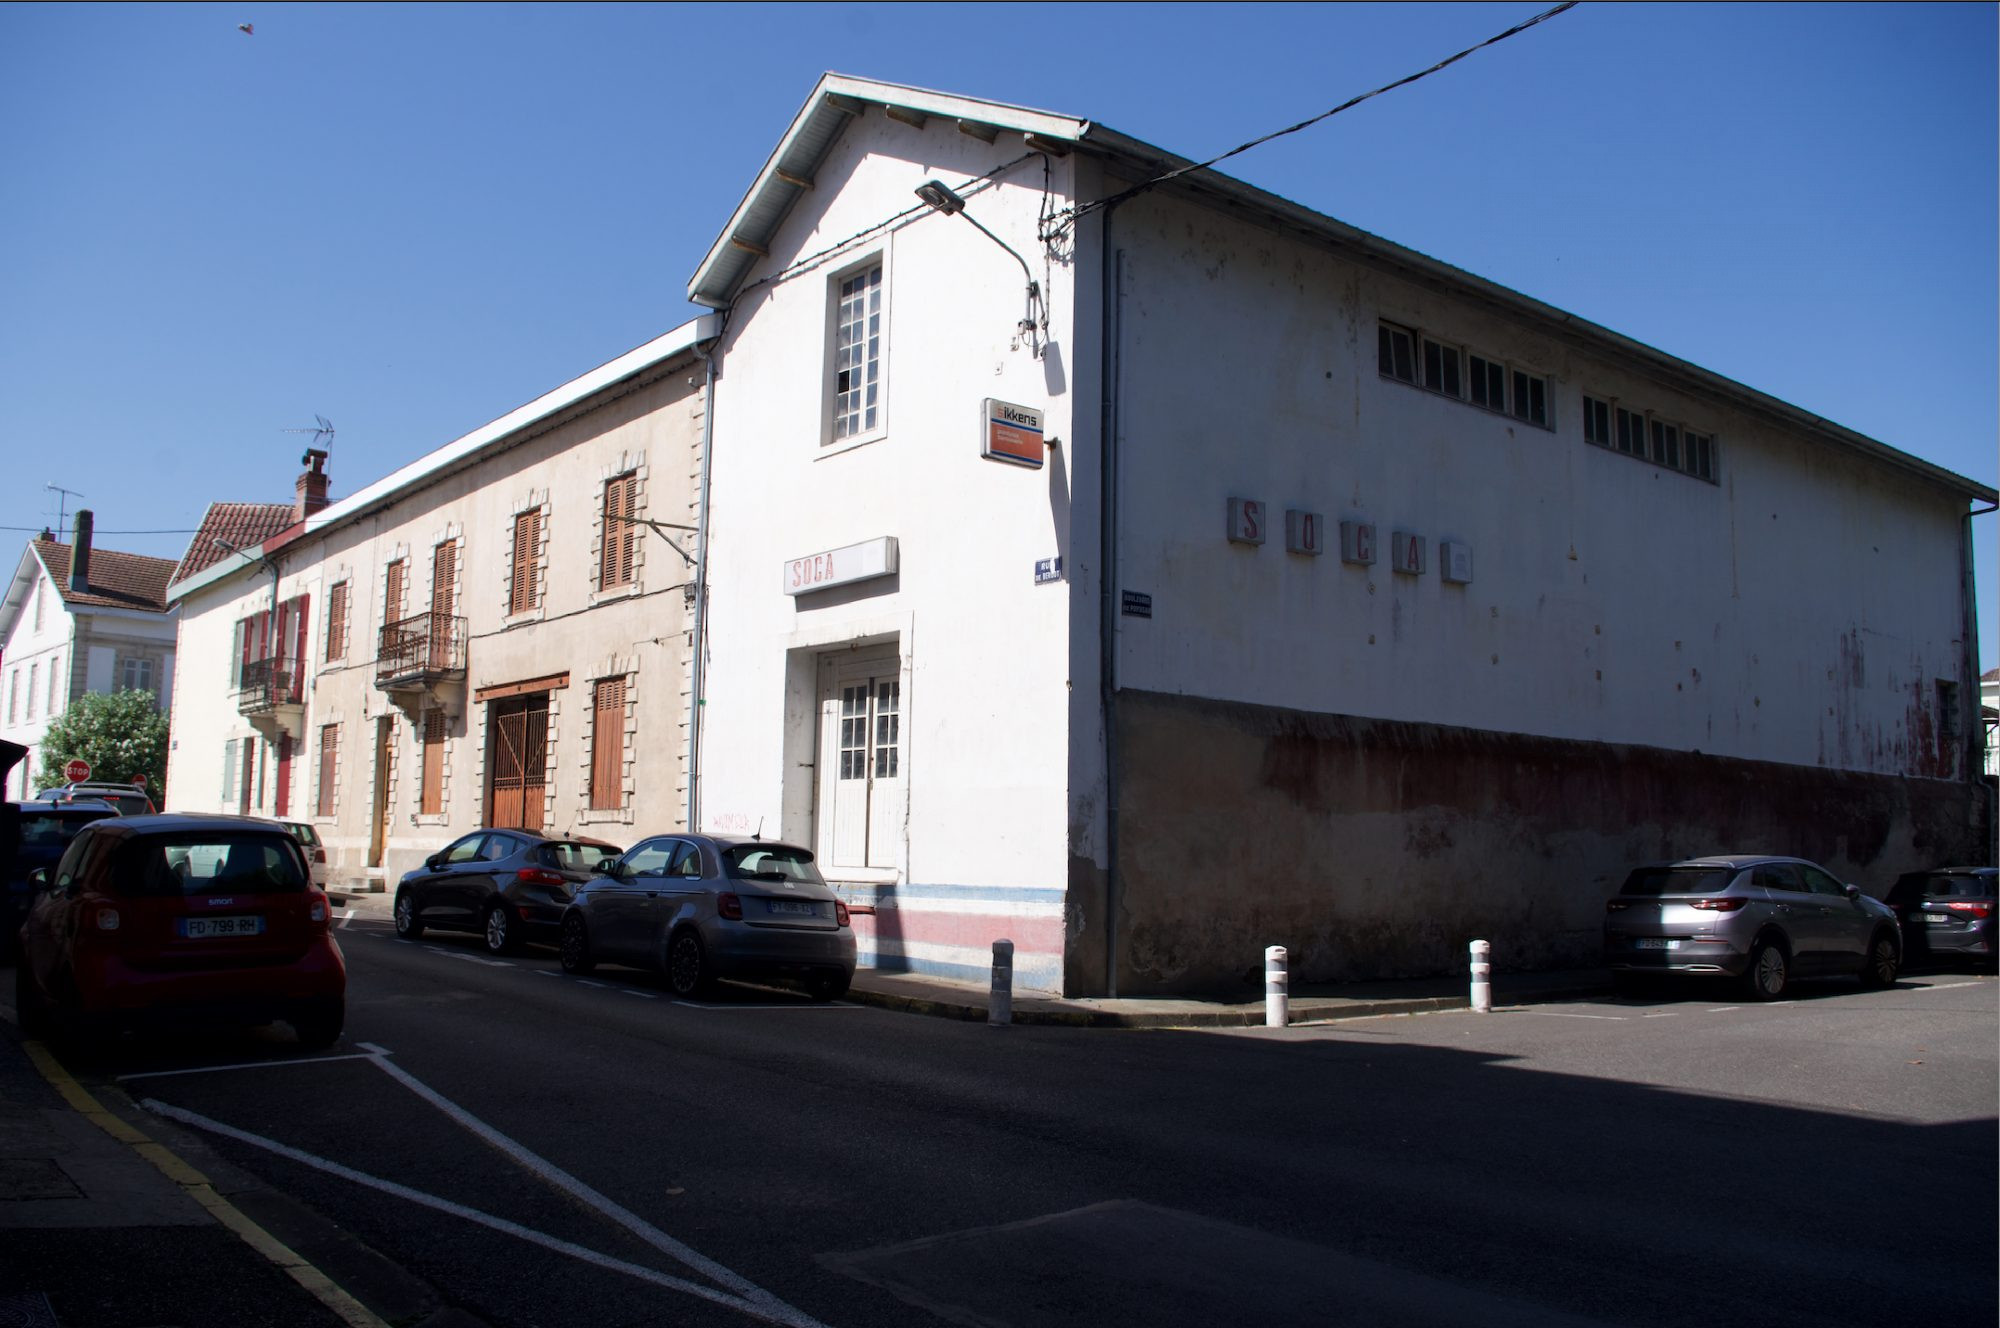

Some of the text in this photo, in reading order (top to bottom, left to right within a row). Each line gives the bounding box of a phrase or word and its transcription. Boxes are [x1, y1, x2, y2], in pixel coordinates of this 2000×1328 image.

[793, 553, 834, 587] SOCA
[1041, 561, 1054, 571] RU
[68, 767, 89, 775] STOP
[208, 898, 234, 906] smart
